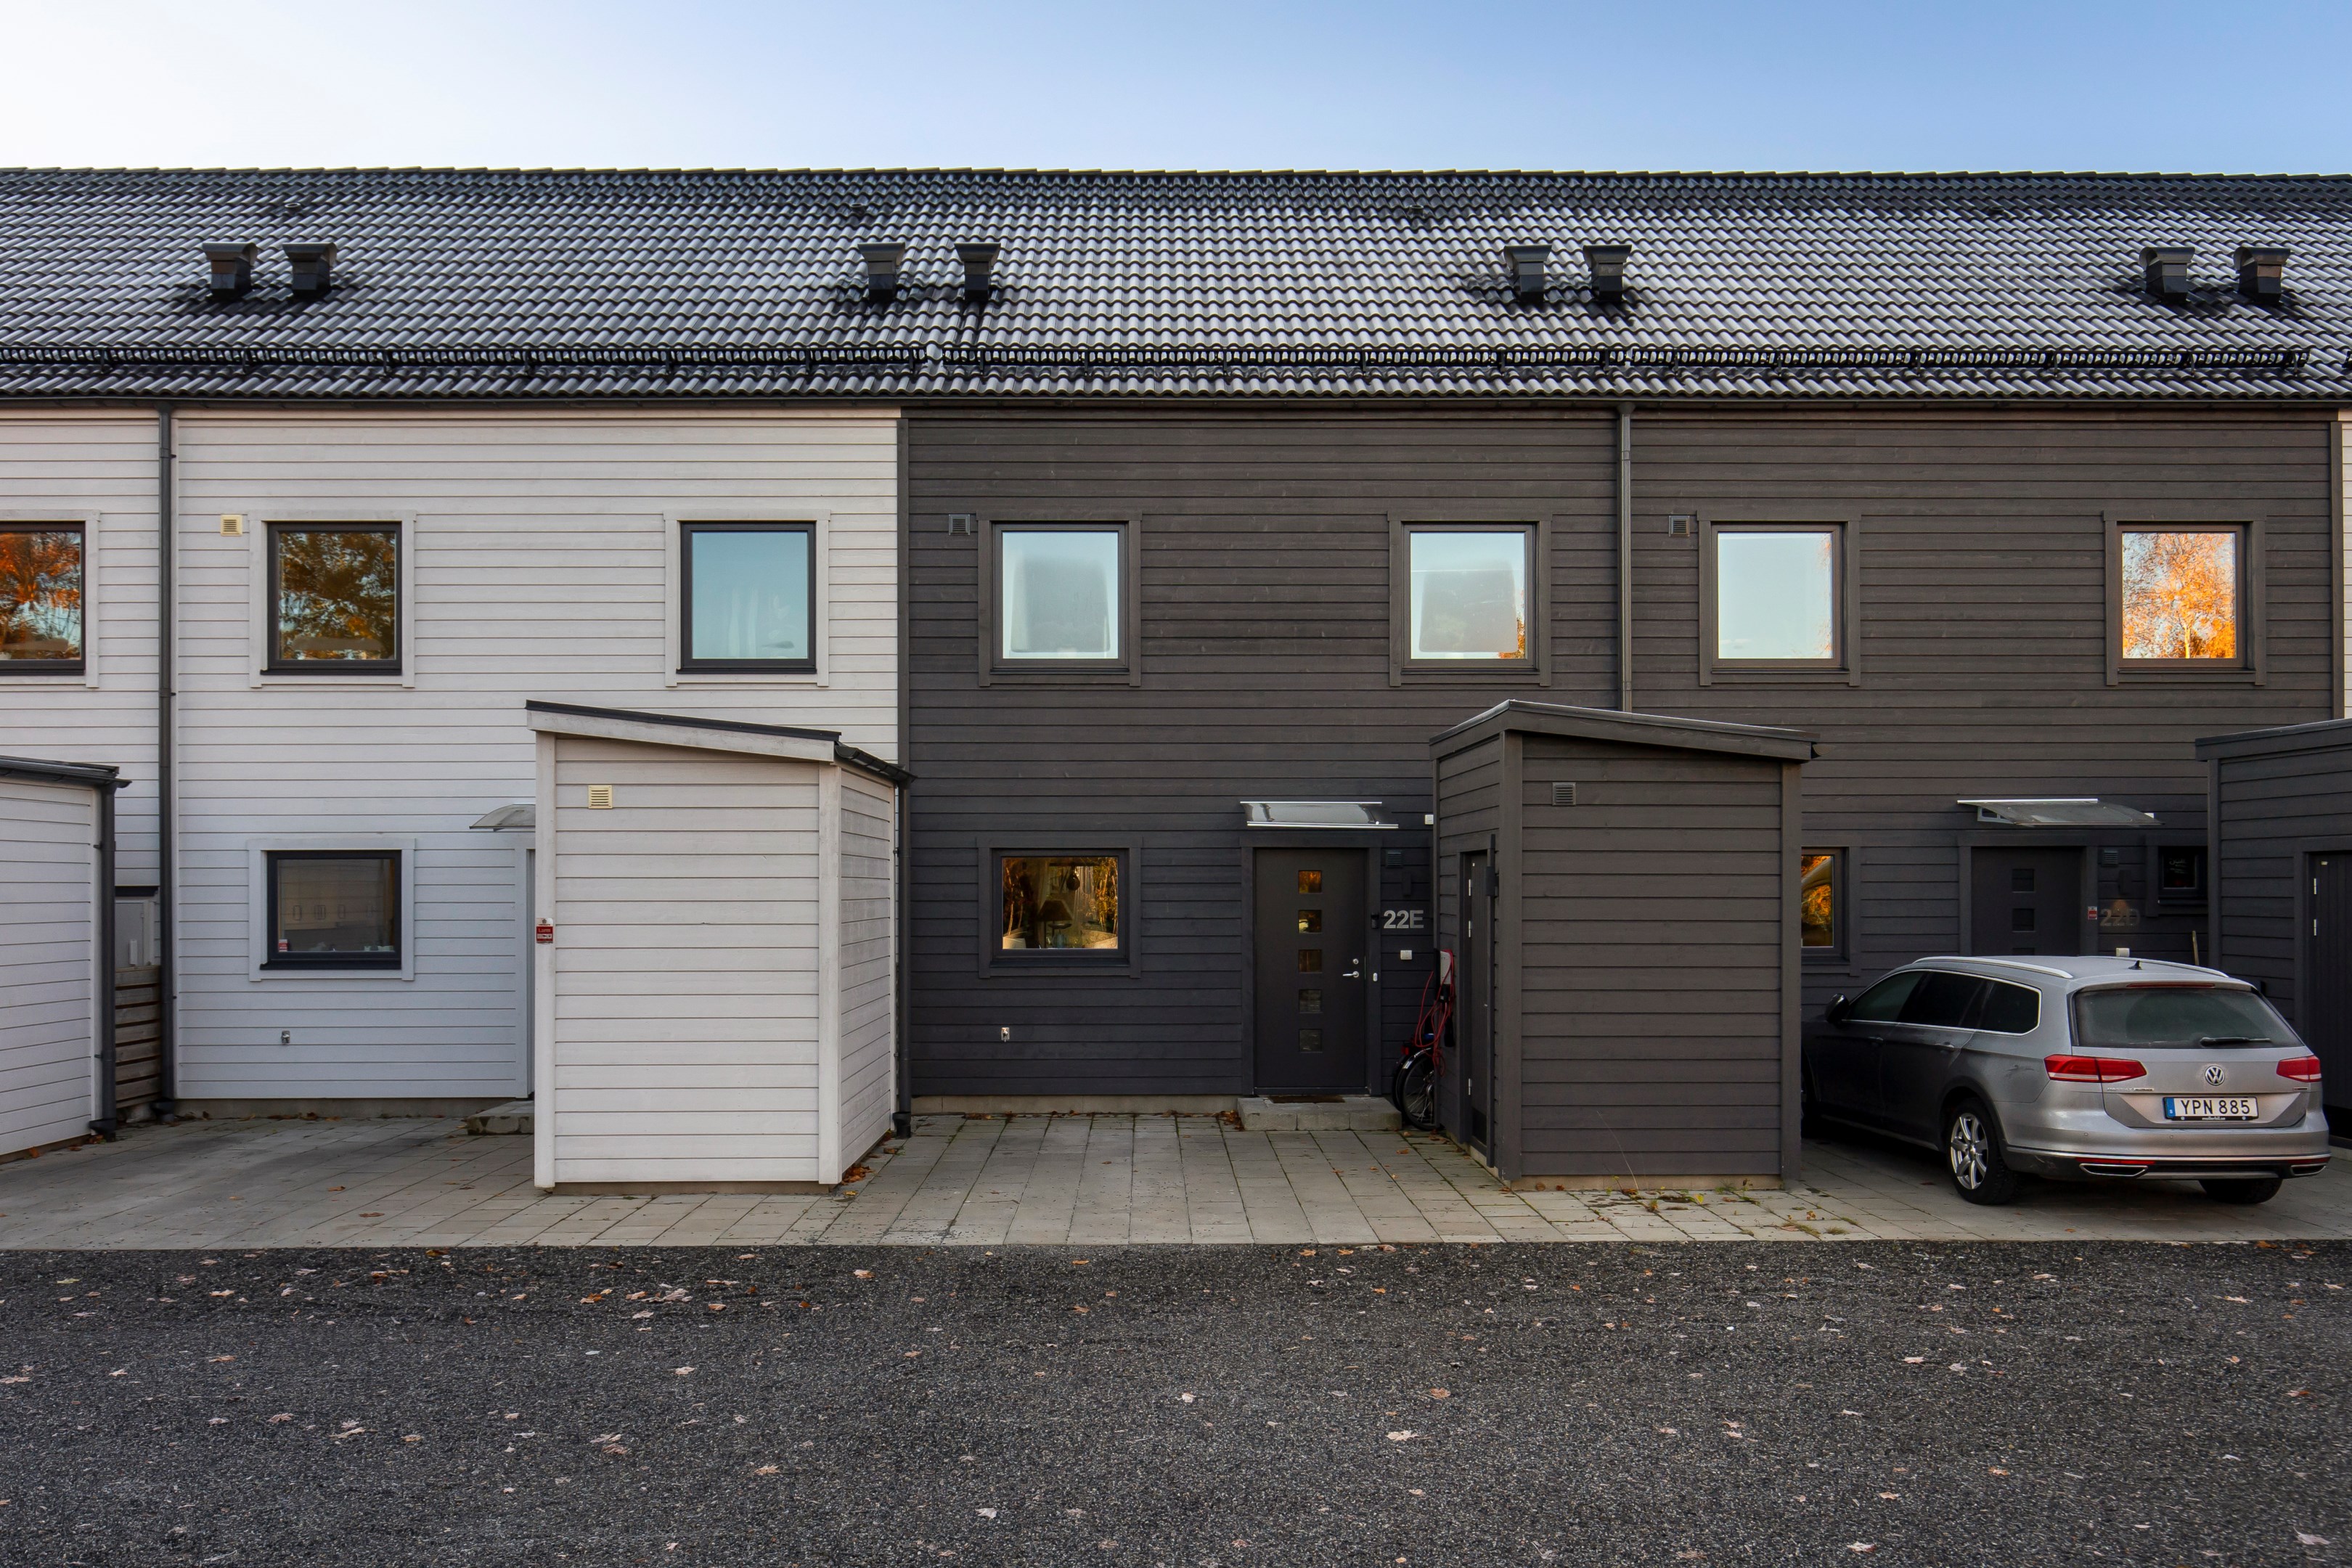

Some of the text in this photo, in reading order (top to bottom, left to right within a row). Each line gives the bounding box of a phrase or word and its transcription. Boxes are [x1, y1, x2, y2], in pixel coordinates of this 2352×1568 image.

[1384, 910, 1424, 928] 22E
[2100, 909, 2141, 926] 22D
[2181, 1100, 2250, 1114] YPN 885
